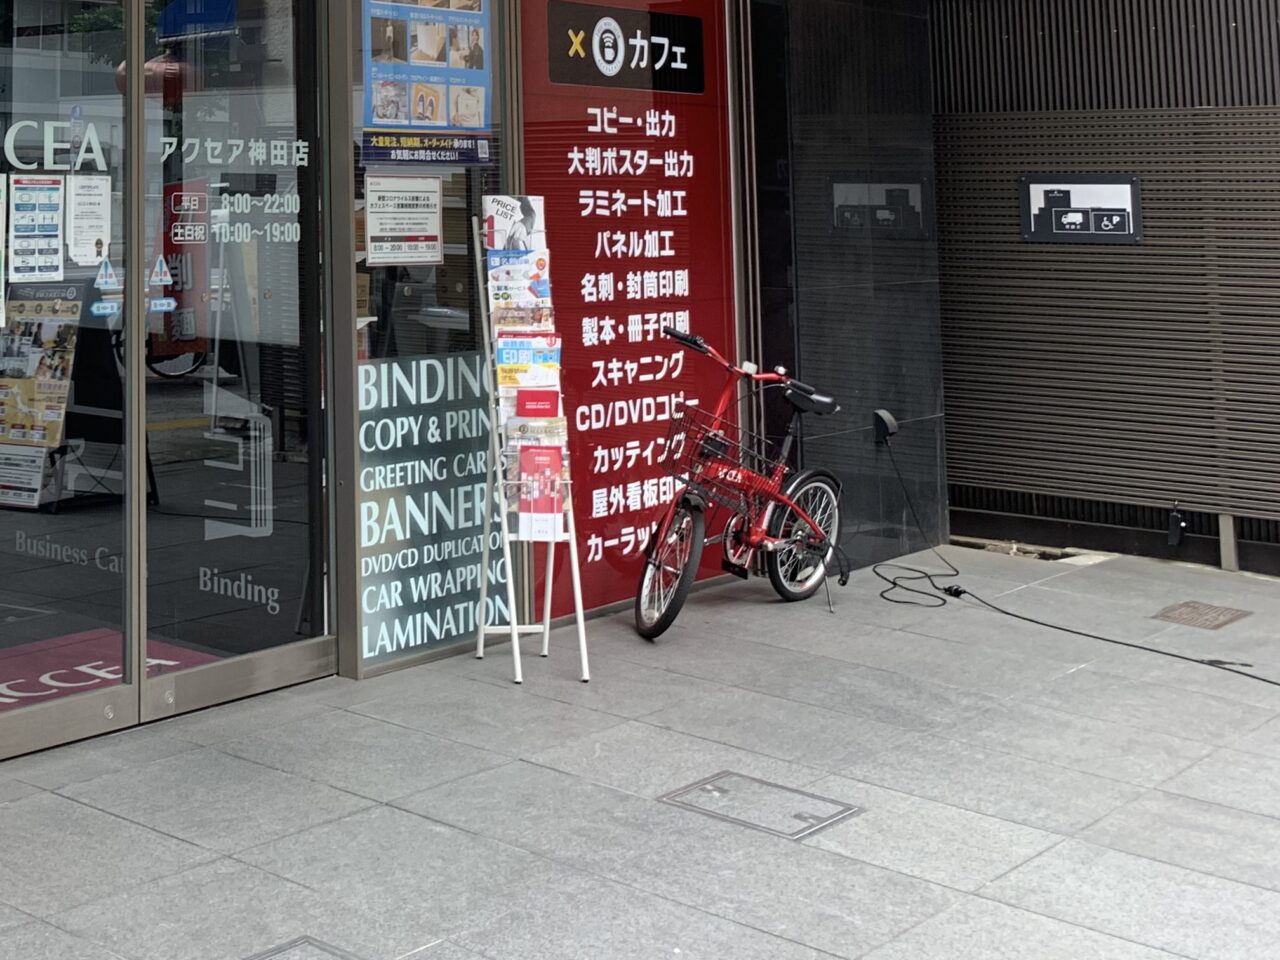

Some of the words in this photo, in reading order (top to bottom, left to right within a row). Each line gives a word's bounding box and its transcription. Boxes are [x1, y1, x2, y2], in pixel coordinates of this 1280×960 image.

[629, 29, 688, 70] カフェ
[587, 106, 676, 137] コピー・出力
[159, 136, 309, 167] アクセア神田店
[567, 146, 694, 177] 大判ポスター出力
[181, 196, 199, 209] 平日
[491, 197, 517, 213] PRICE
[495, 208, 515, 220] LIST
[579, 189, 688, 217] ラミネート加工
[174, 226, 205, 240] 土日祝
[595, 229, 675, 259] パネル加工
[581, 269, 689, 302] 名刺・封筒印刷
[581, 310, 690, 346] 製本・冊子印刷
[591, 350, 684, 387] スキャニング
[576, 391, 699, 431] CD/DVDコピー
[359, 415, 423, 452] COPY
[428, 416, 442, 444] &
[446, 408, 492, 441] PRIN
[594, 431, 686, 474] カッティング
[360, 457, 446, 492] GREETING
[453, 449, 507, 477] CARS
[16, 530, 88, 567] Business
[361, 547, 418, 577] DVD/CD
[423, 530, 504, 565] DUPLICATO
[199, 567, 280, 615] Binding
[362, 581, 403, 614] CAR
[362, 594, 511, 660] LAMINATION
